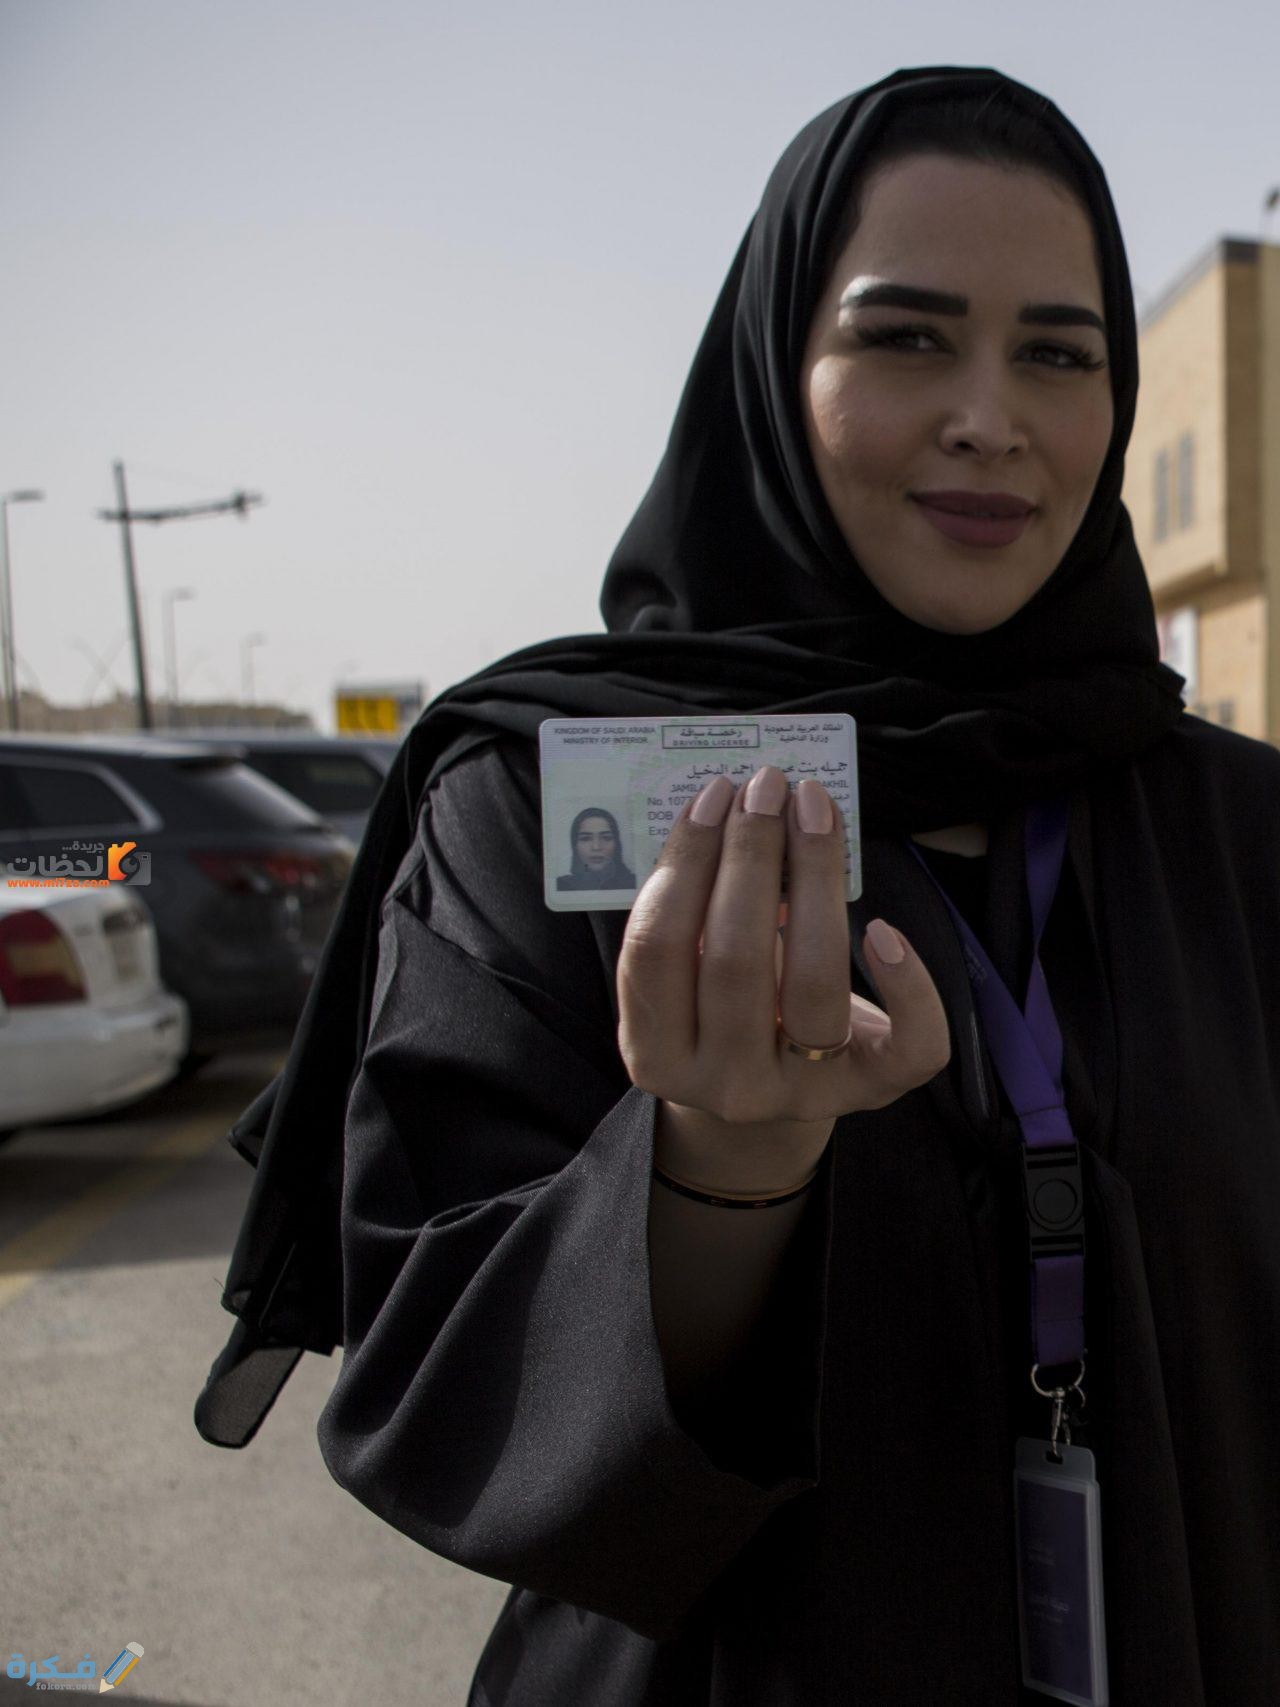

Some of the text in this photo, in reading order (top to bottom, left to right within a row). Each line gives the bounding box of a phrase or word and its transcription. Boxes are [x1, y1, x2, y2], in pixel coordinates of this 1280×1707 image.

[554, 726, 656, 735] KINGDOM OF SAUDI ARABIA
[563, 736, 649, 745] MINISTRY OF INTERIOR
[672, 739, 709, 747] DRIVING
[648, 810, 674, 821] DOB
